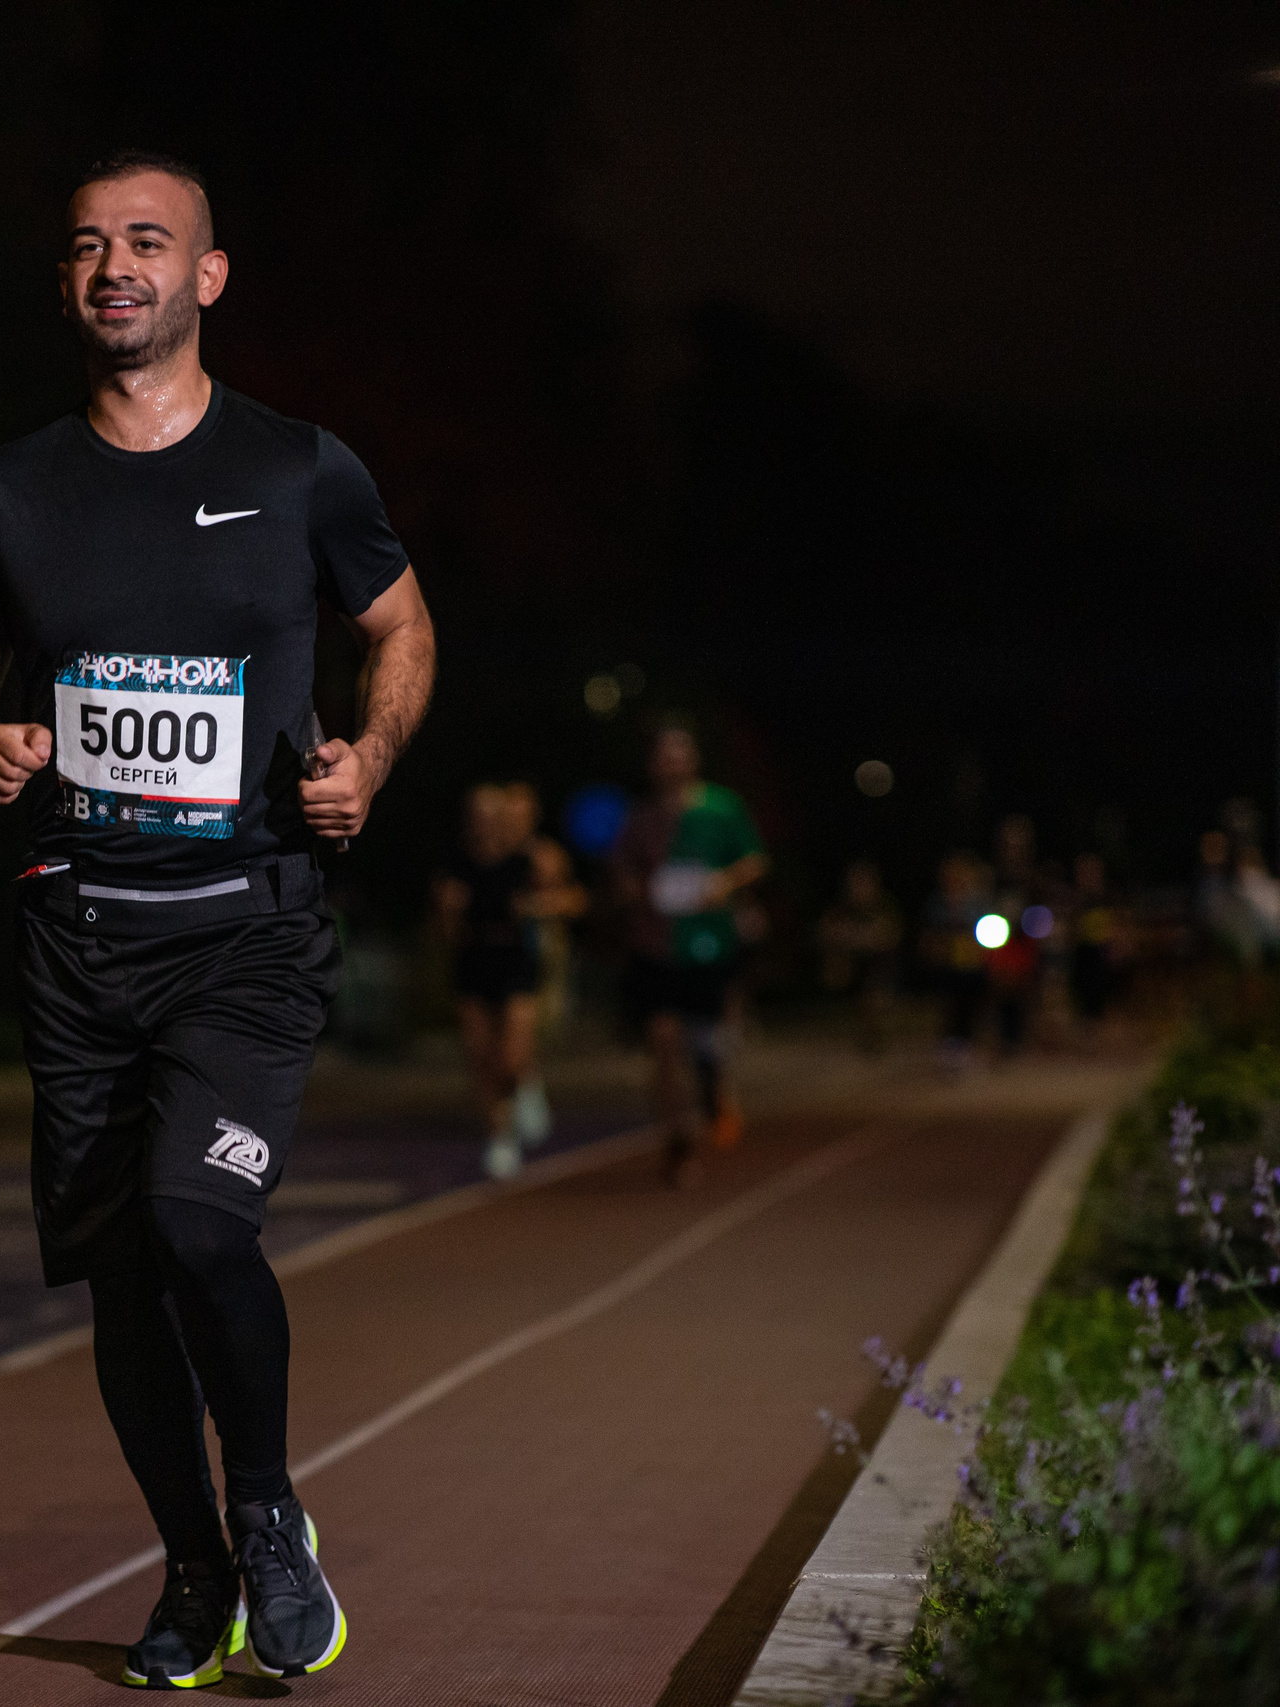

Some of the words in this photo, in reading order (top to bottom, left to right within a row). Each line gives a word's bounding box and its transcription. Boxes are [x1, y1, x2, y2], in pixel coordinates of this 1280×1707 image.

[78, 651, 231, 687] НОЧНОЙ
[80, 703, 218, 765] 5000
[110, 766, 178, 785] СЕРГЕЙ
[74, 790, 90, 820] B
